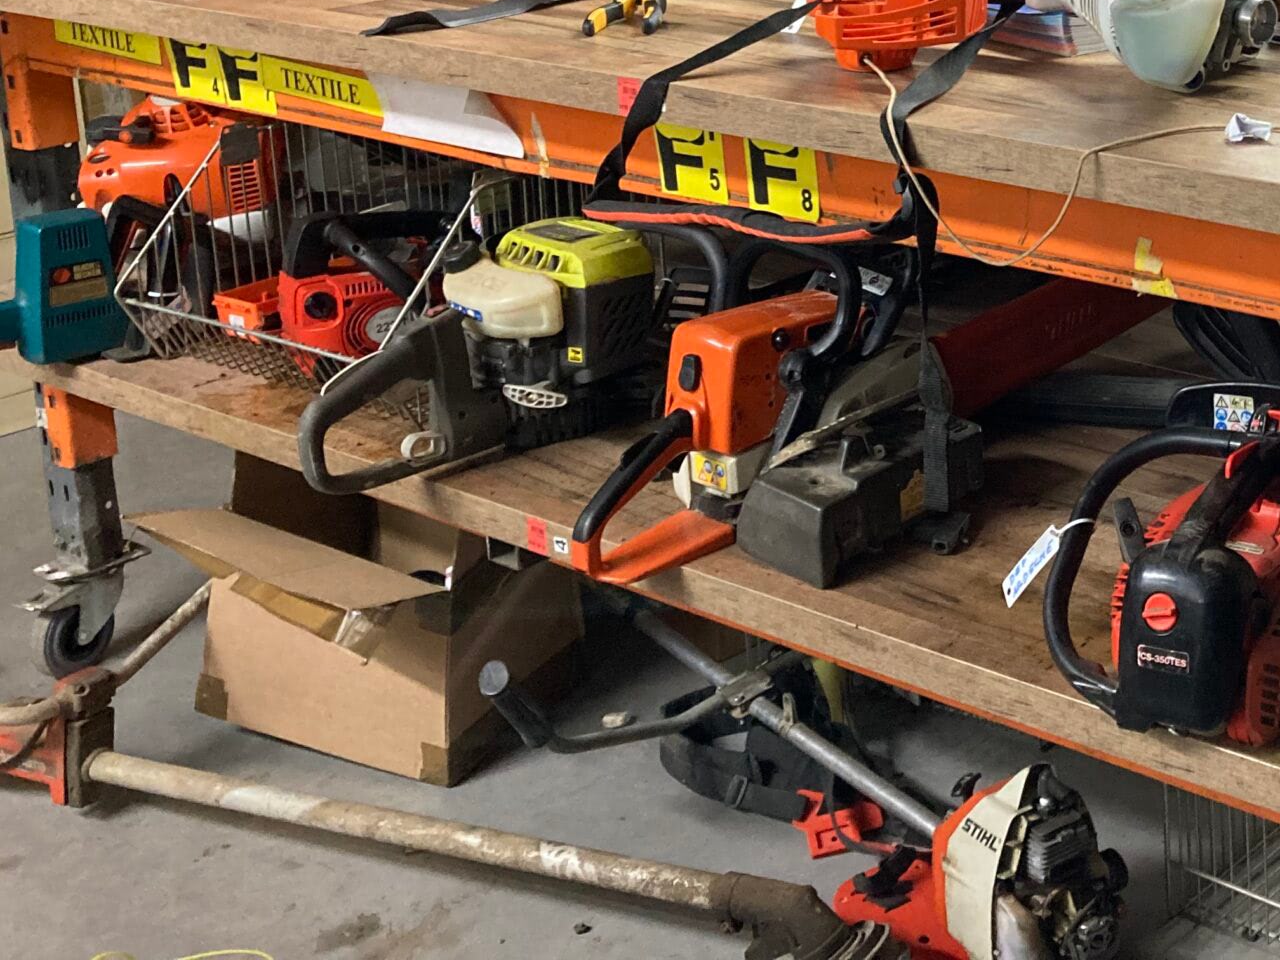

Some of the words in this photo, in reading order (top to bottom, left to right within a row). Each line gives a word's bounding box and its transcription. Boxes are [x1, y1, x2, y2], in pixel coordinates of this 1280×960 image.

[69, 22, 136, 53] TEXTILE
[213, 77, 220, 96] 4
[280, 67, 361, 105] TEXTILE
[709, 168, 721, 190] 5
[801, 188, 814, 212] 8
[1140, 652, 1187, 668] CS-350TES
[961, 817, 998, 853] STIHL
